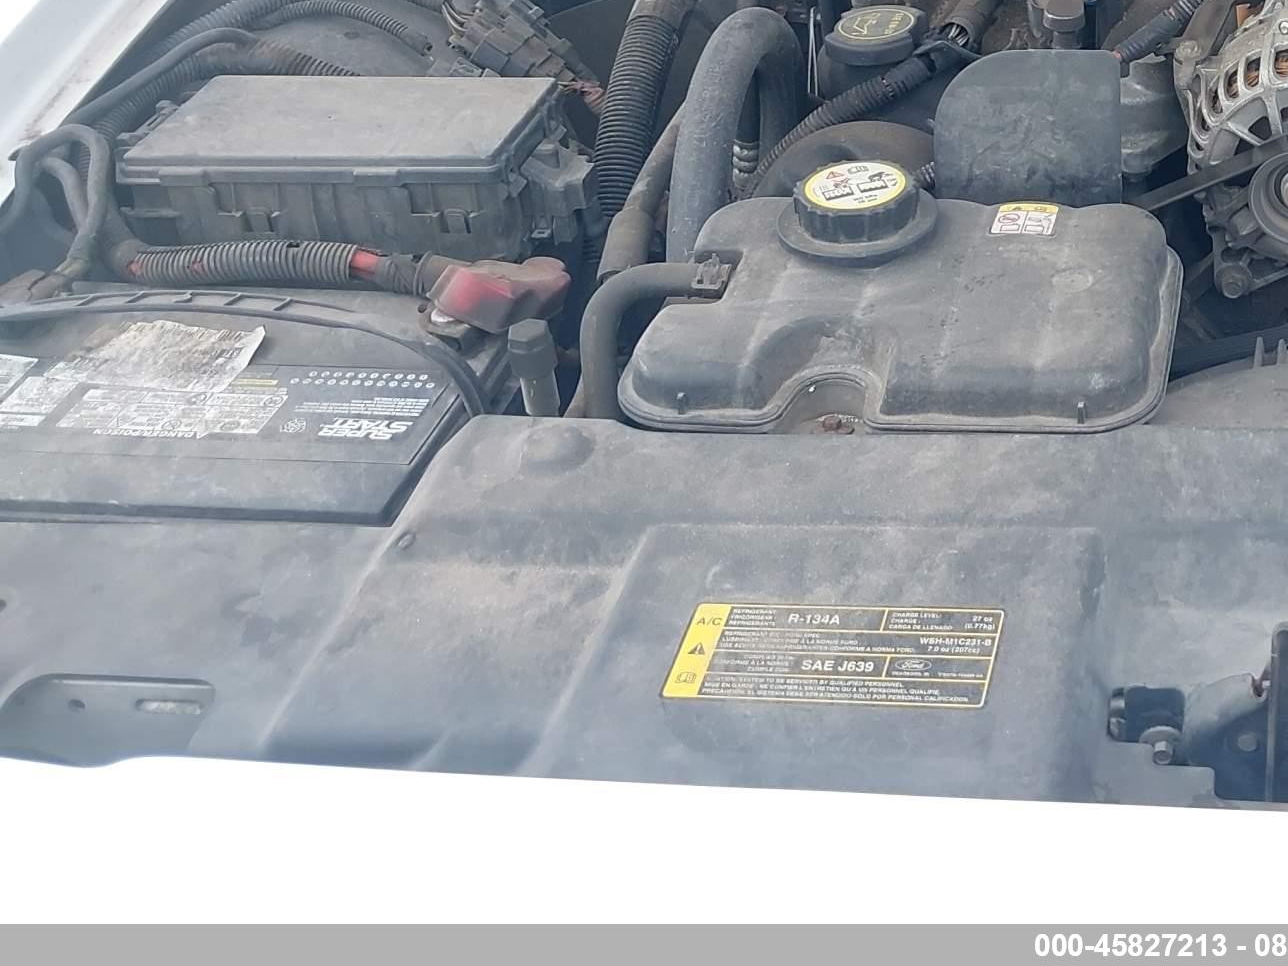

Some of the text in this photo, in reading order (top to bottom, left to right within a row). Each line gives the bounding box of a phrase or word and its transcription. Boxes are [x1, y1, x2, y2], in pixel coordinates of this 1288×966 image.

[317, 427, 393, 440] SUPER
[696, 617, 722, 626] A/C
[788, 613, 840, 625] R-134A
[801, 659, 874, 672] SAE J639
